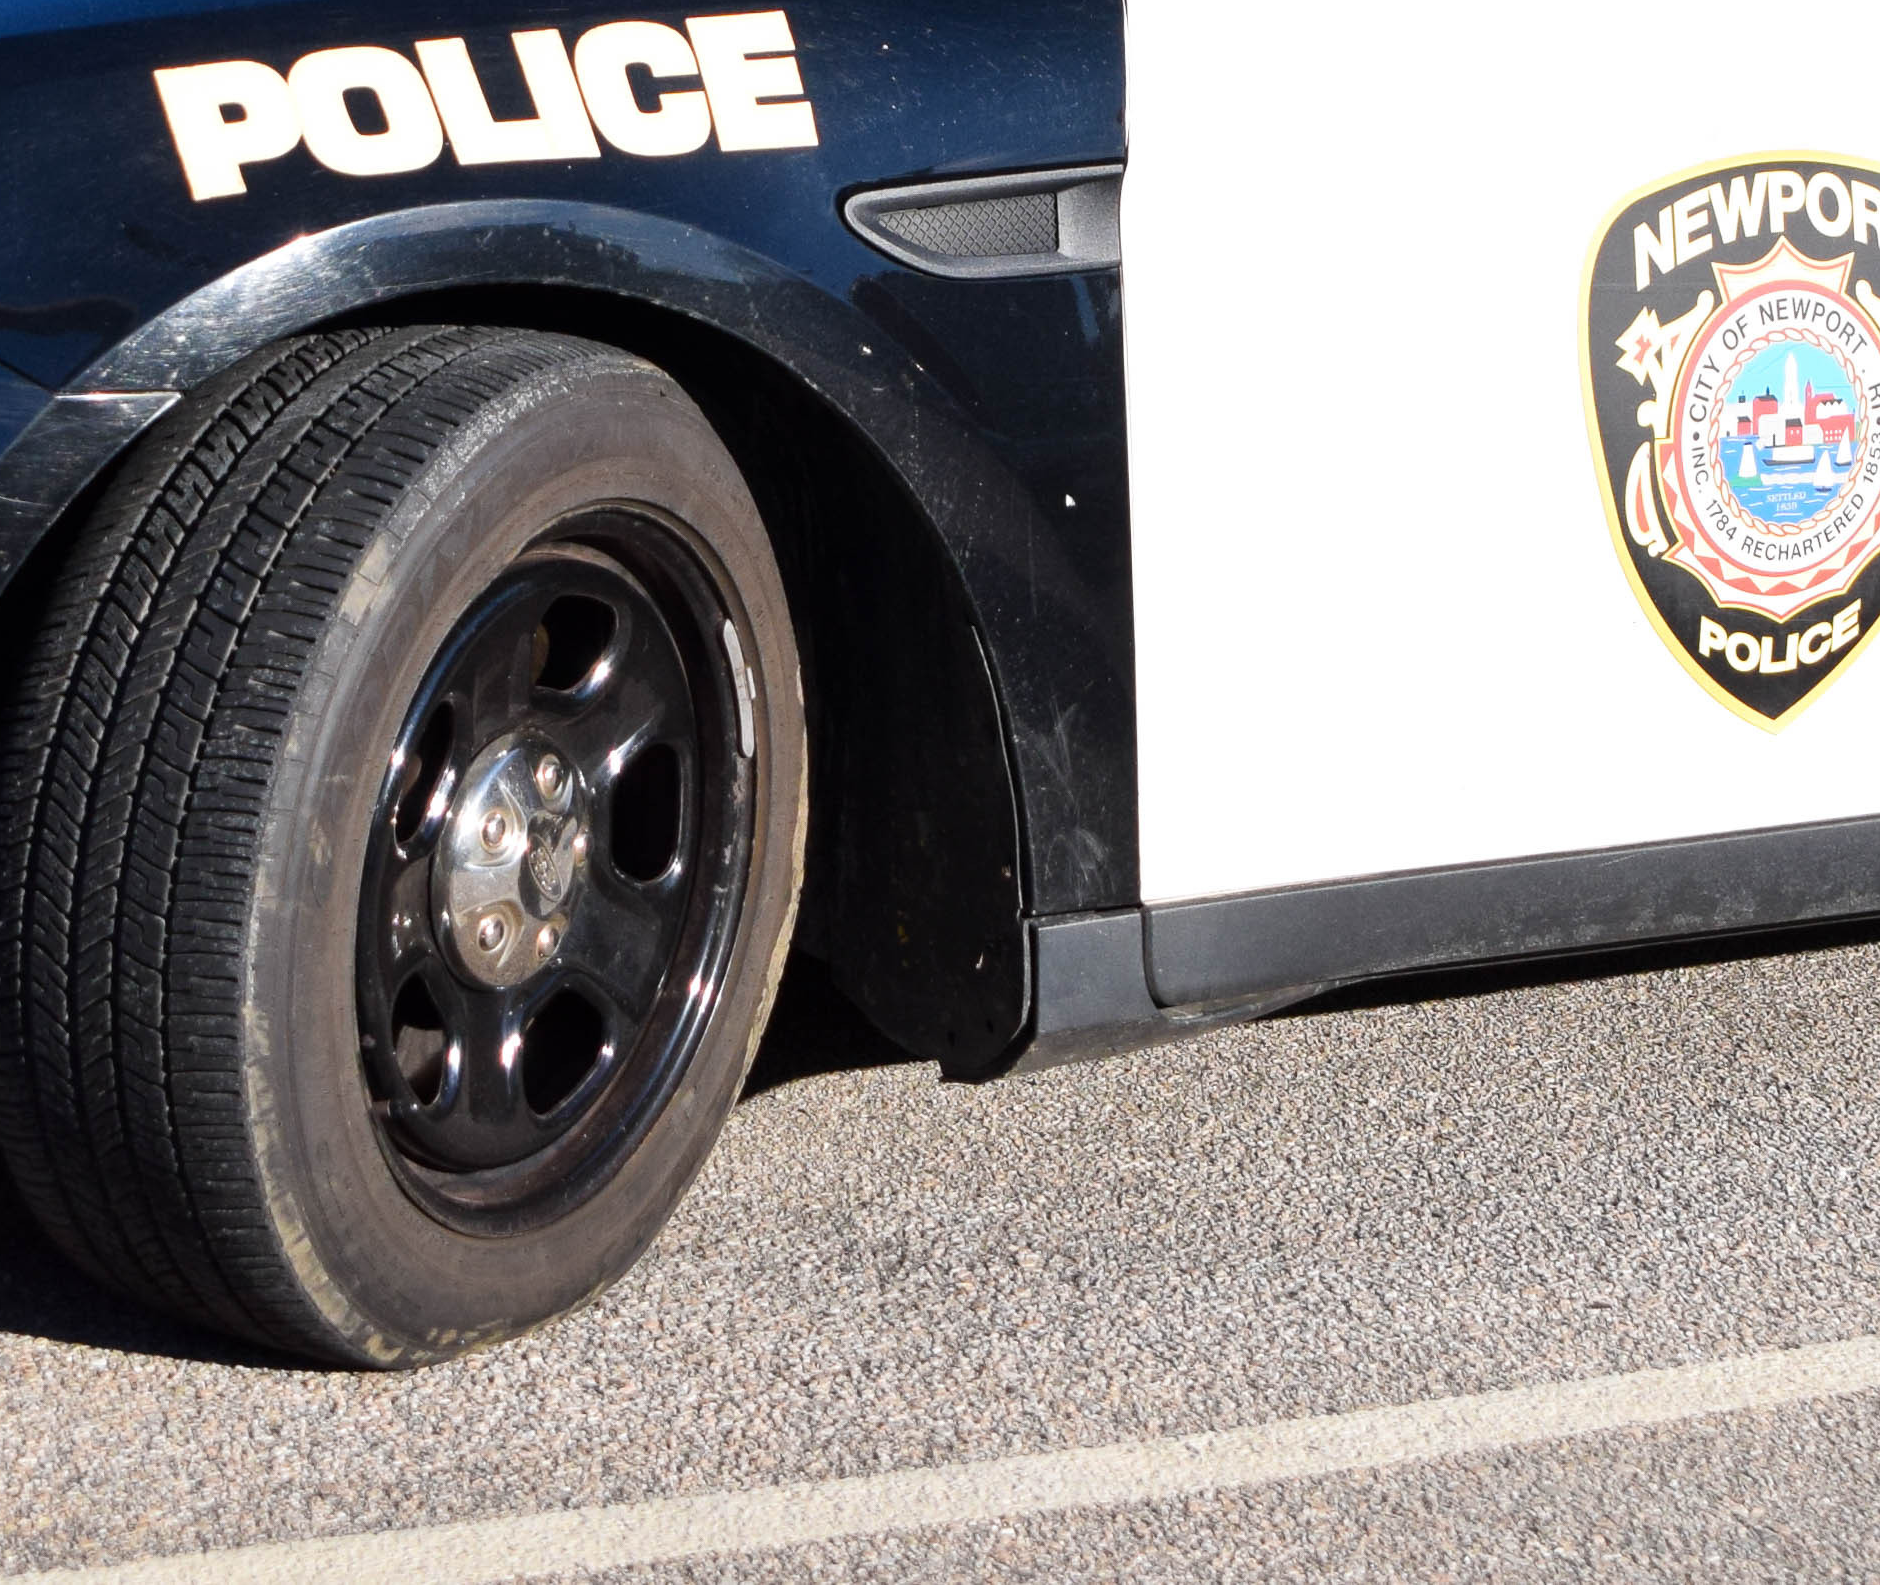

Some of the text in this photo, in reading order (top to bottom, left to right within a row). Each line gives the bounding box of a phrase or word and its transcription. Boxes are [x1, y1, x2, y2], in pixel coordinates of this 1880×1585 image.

[153, 9, 820, 203] POLICE
[1689, 355, 1720, 422] CITY
[1722, 315, 1749, 350] OF
[1758, 297, 1868, 354] NEWPORT
[1705, 499, 1738, 541] 1784
[1740, 493, 1865, 561] RECHARTERED
[1698, 598, 1862, 674] POLICE
